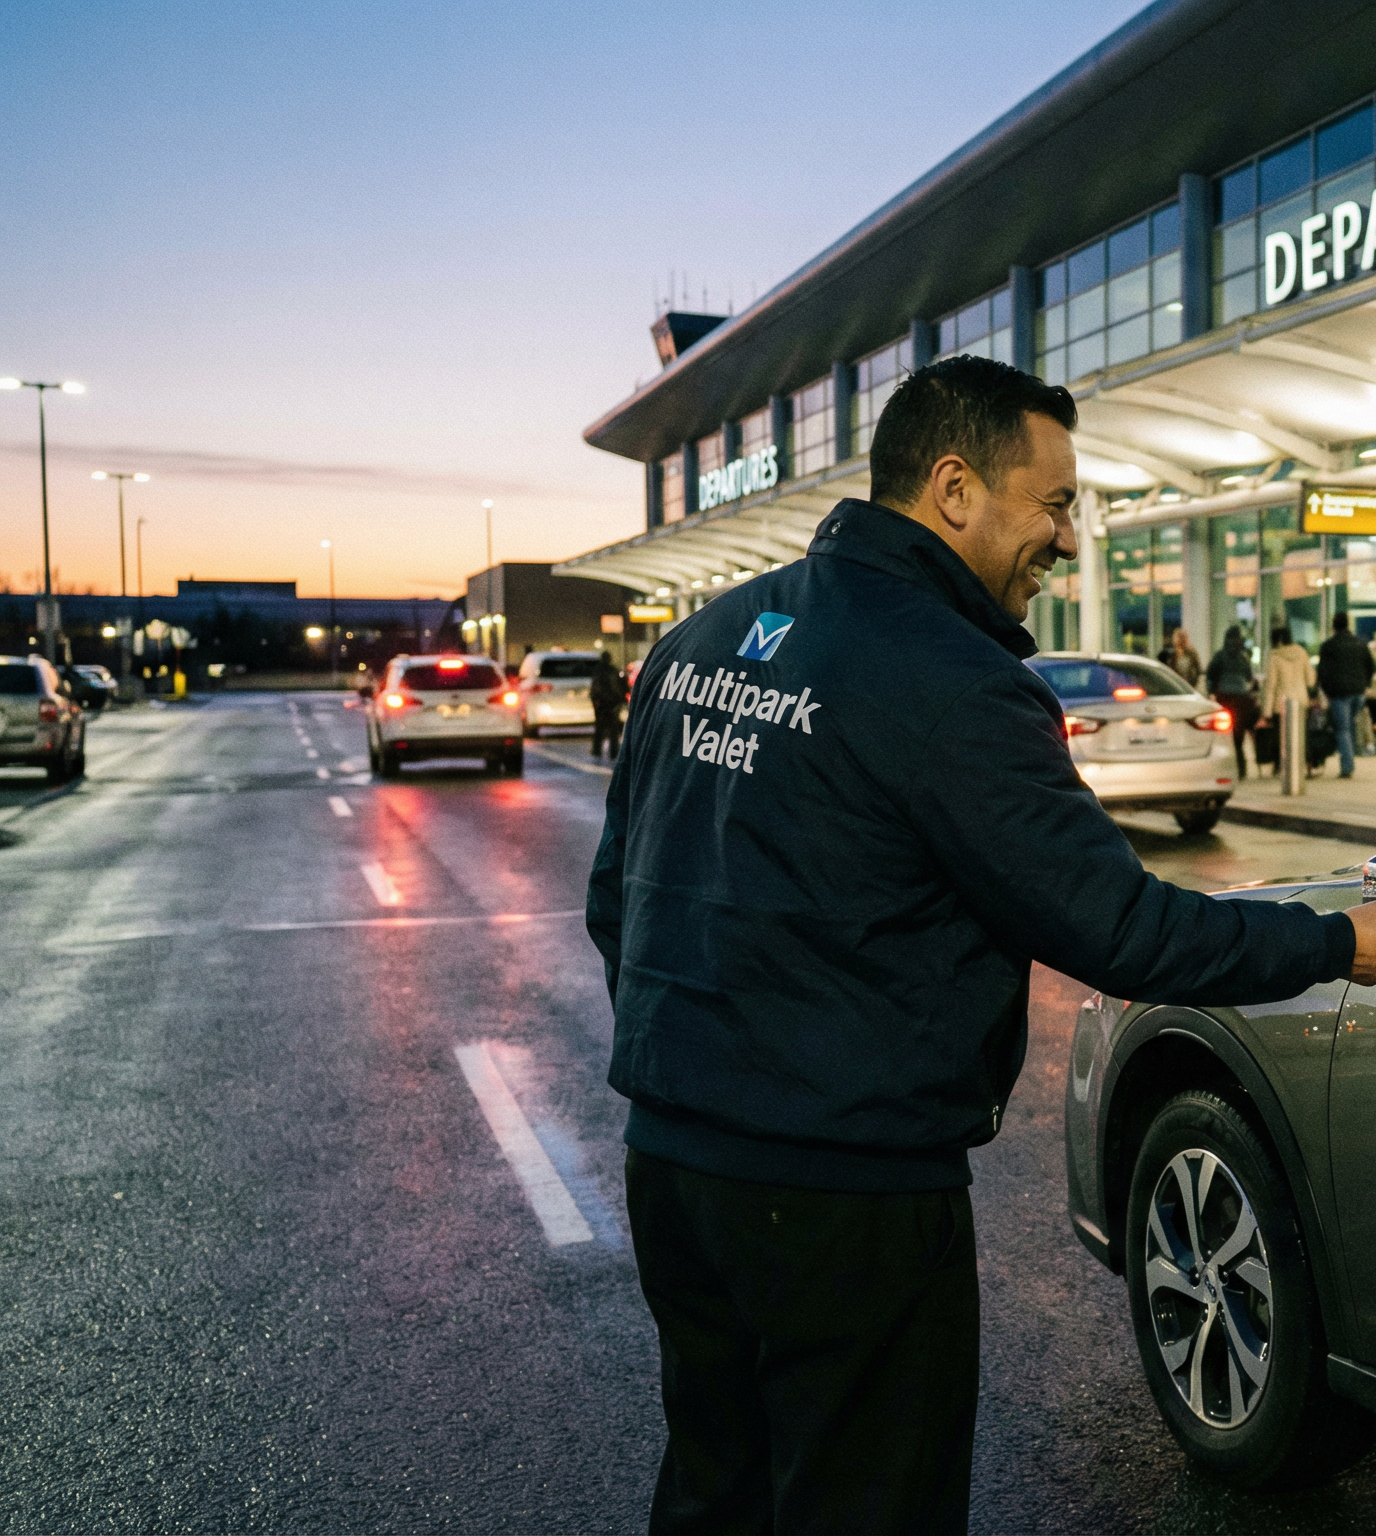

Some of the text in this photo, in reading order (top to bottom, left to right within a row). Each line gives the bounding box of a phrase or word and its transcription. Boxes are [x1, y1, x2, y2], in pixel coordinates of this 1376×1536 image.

[698, 444, 779, 511] DEPARTURES
[658, 660, 822, 735] Multipark
[681, 714, 760, 775] Valet
